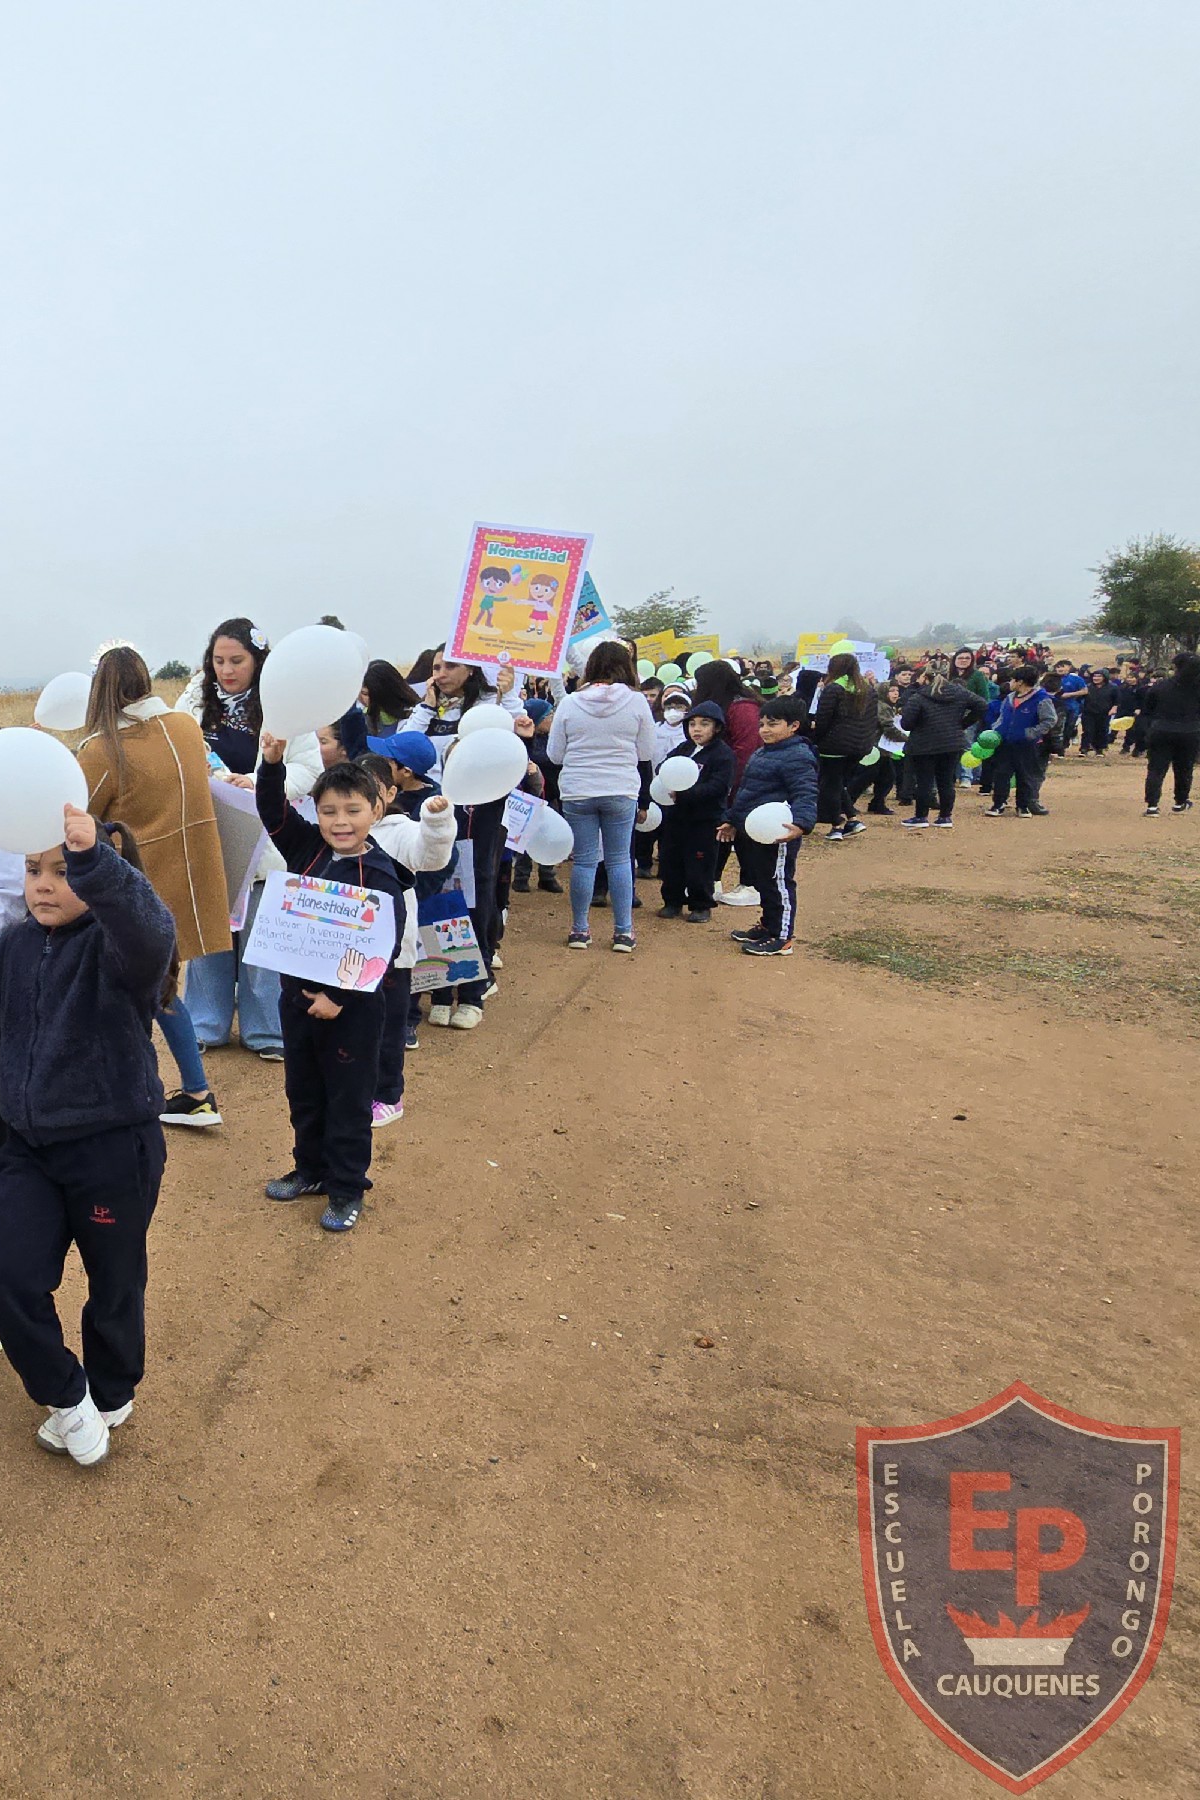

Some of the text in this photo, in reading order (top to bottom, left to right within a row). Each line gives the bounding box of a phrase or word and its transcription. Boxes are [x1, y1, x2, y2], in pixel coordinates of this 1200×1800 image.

[487, 542, 568, 564] Honestidad
[296, 892, 360, 918] Honestidad
[259, 914, 271, 924] Es
[307, 923, 316, 935] la
